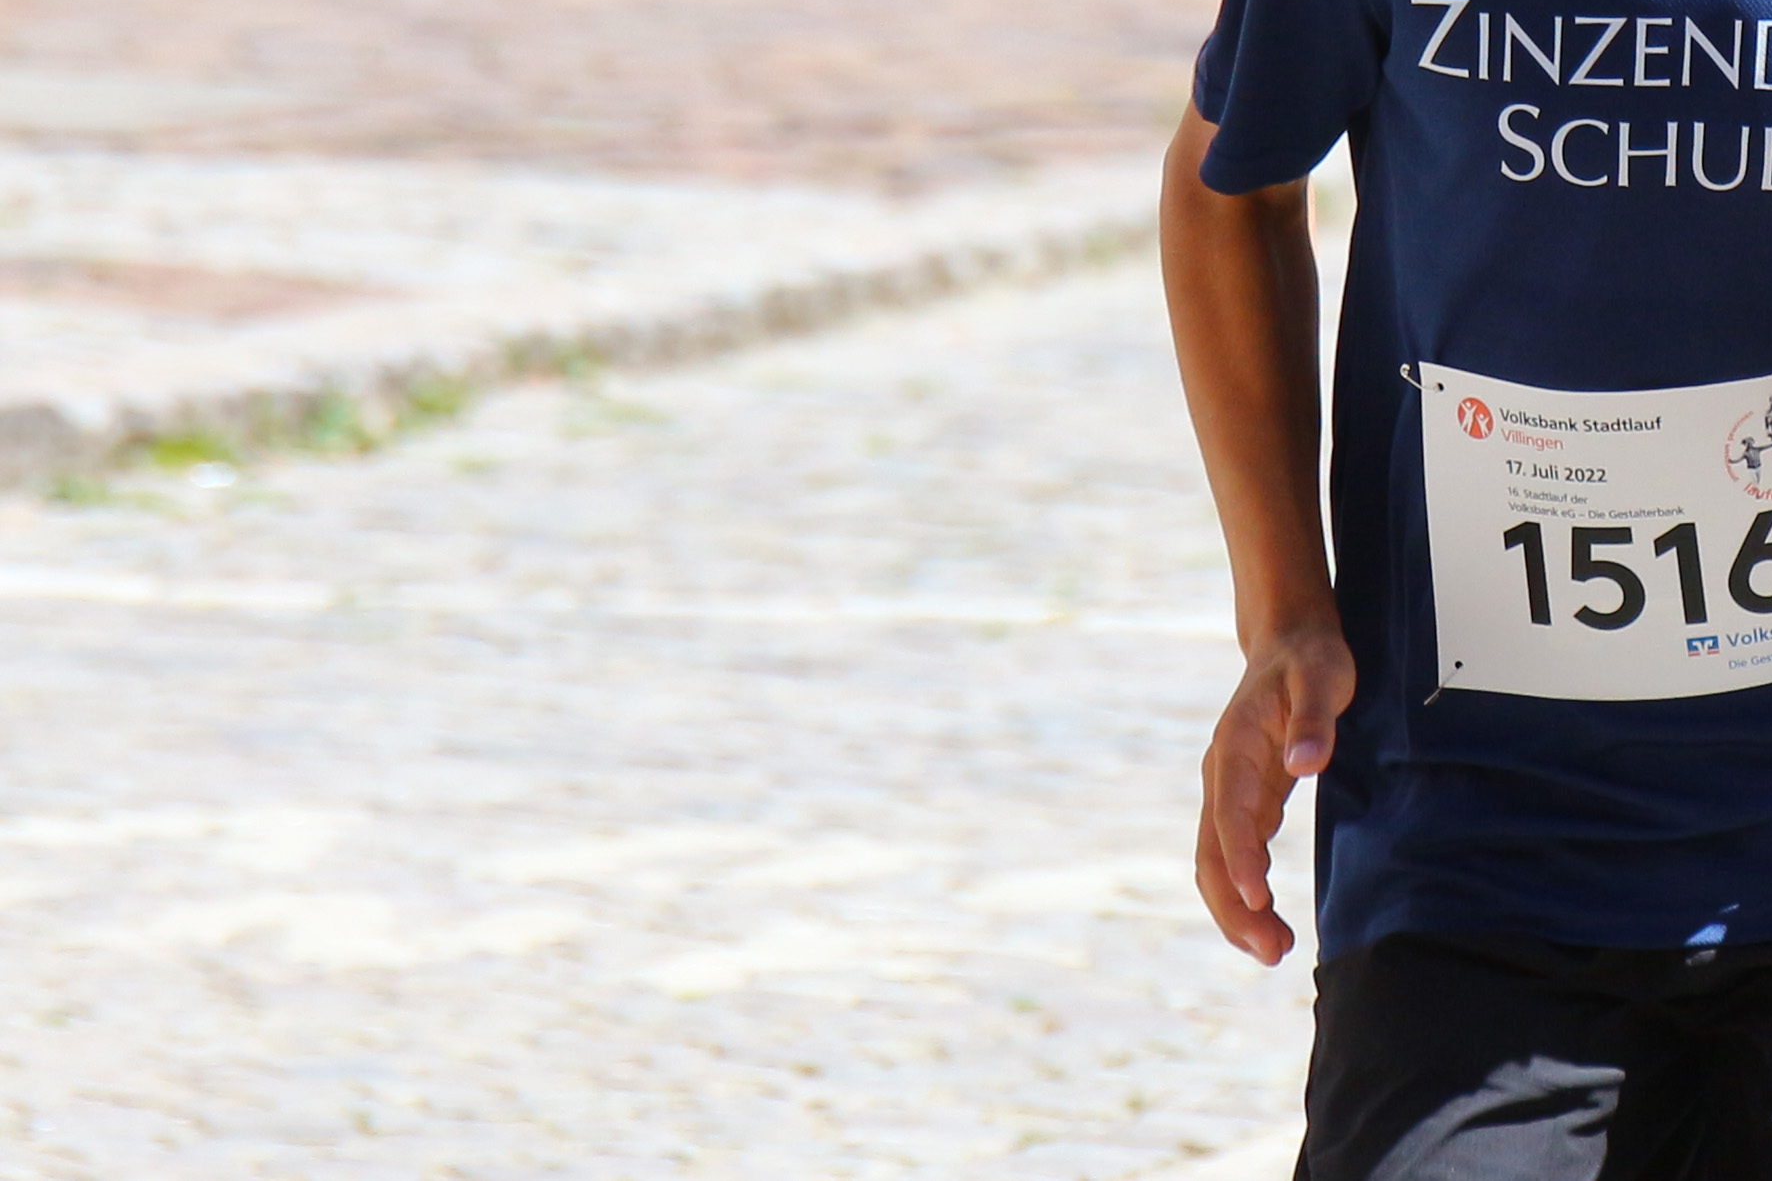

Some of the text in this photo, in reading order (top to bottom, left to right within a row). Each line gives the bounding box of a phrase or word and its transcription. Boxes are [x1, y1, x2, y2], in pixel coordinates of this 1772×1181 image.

[1499, 407, 1662, 433] Volksbank Stadtlauf
[1501, 428, 1564, 451] Villingen
[1505, 459, 1608, 483] 17. Juli 2022
[1507, 486, 1588, 504] 16. Stadtlauf der
[1508, 501, 1558, 517] Volksbank
[1561, 508, 1576, 519] eG
[1588, 509, 1606, 519] Die
[1609, 506, 1685, 520] Gestalterbank
[1728, 659, 1748, 670] Die
